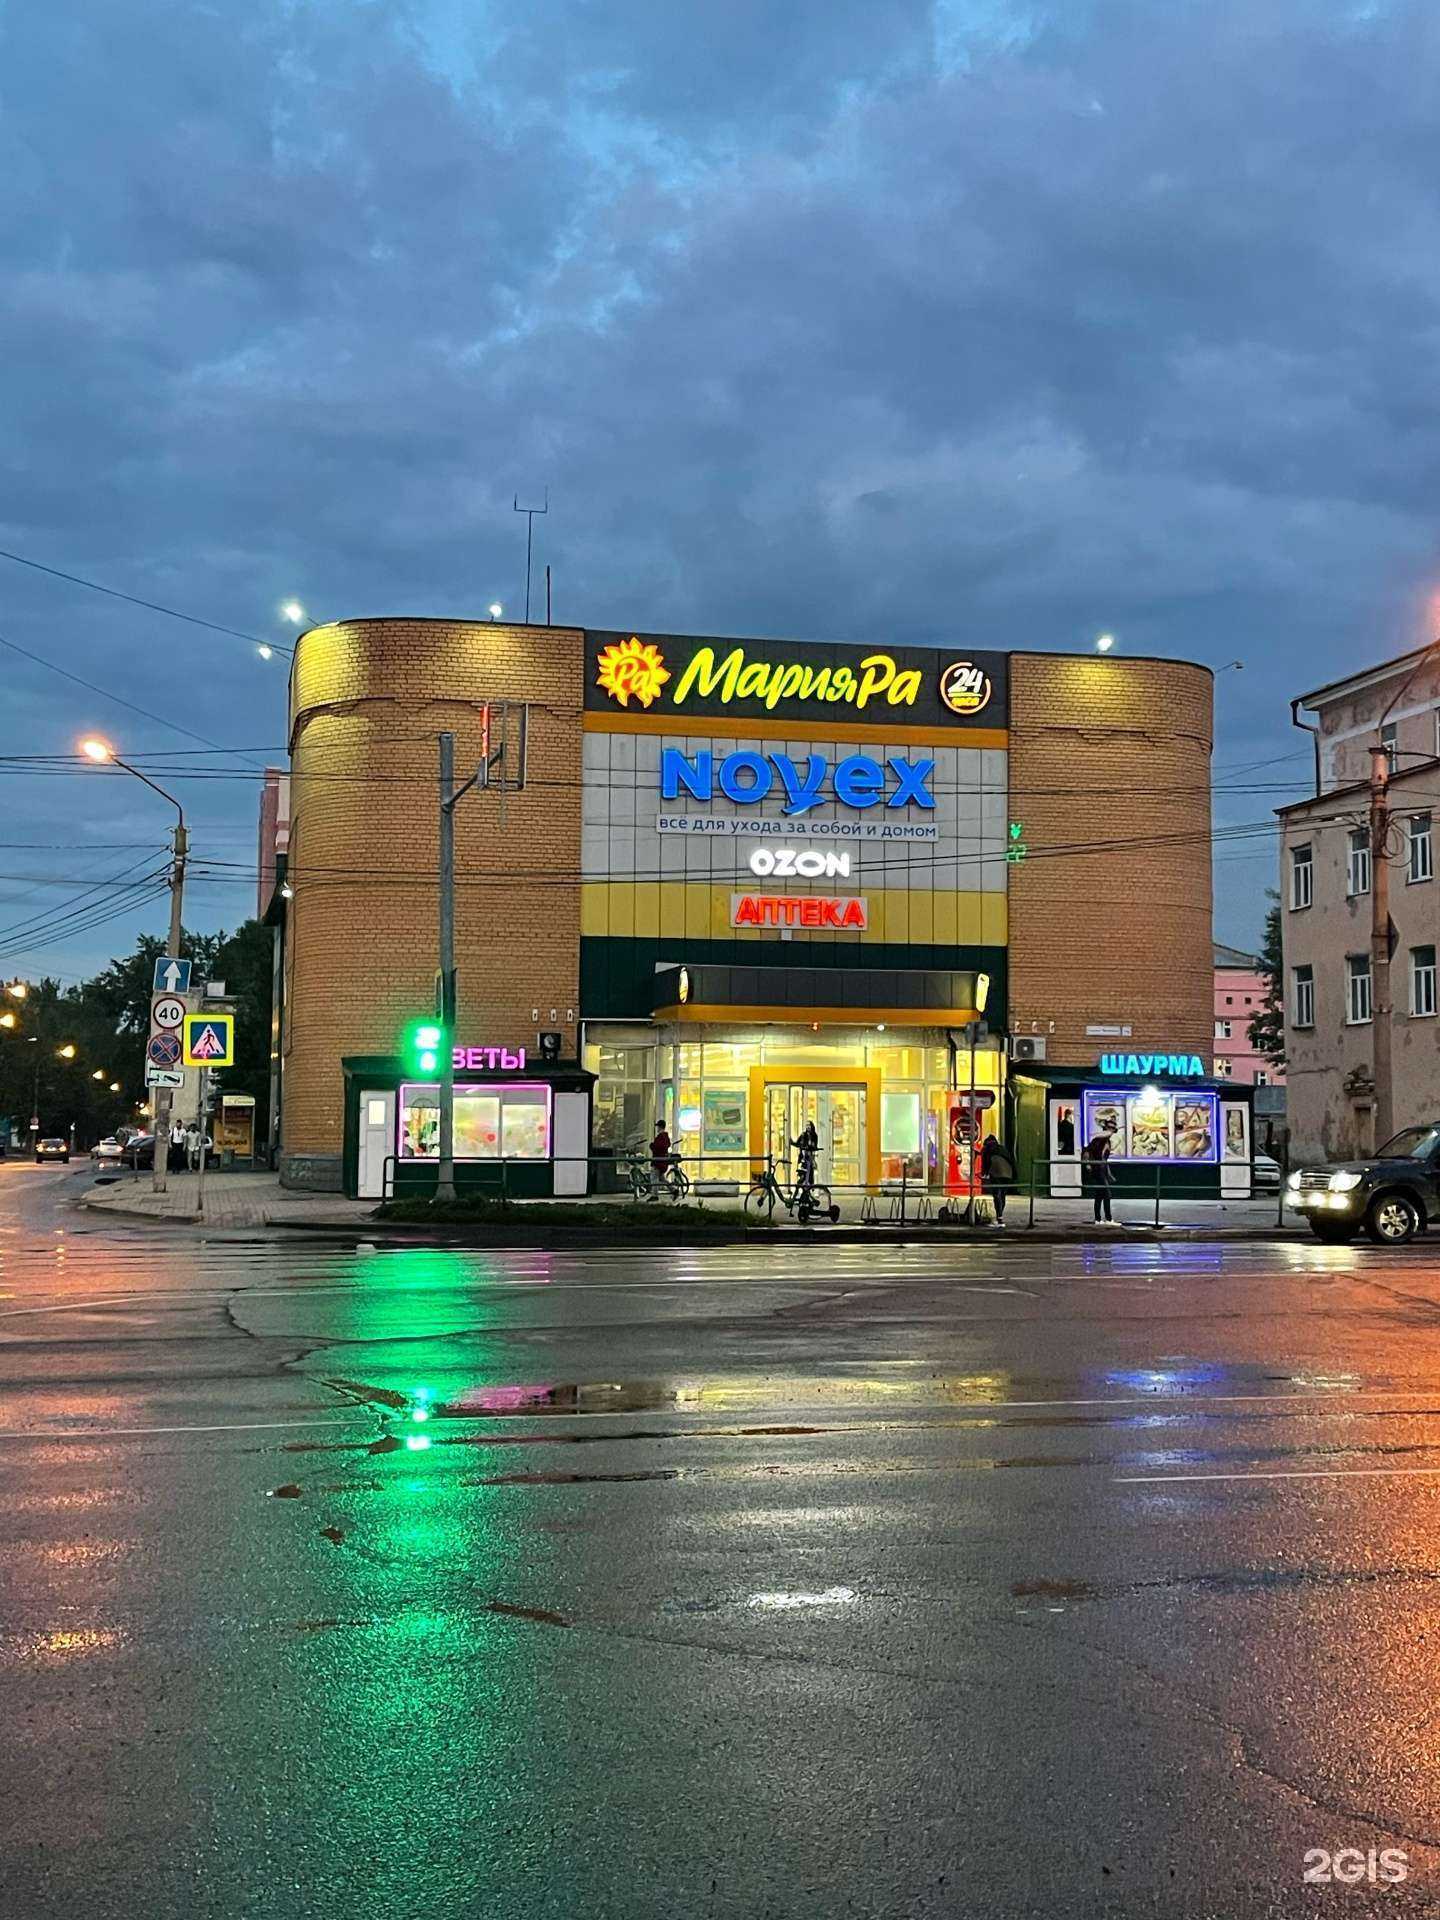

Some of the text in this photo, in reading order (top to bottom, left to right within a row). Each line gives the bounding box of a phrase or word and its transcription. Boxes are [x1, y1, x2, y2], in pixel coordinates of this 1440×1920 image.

[947, 667, 984, 694] 24
[659, 817, 936, 838] всё для ухода за собой и домом
[750, 848, 850, 878] OZON
[735, 896, 865, 927] АПТЕКА
[159, 1007, 180, 1020] 40
[451, 1047, 526, 1070] ВЕТЫ
[1101, 1054, 1204, 1075] ШАУРМА
